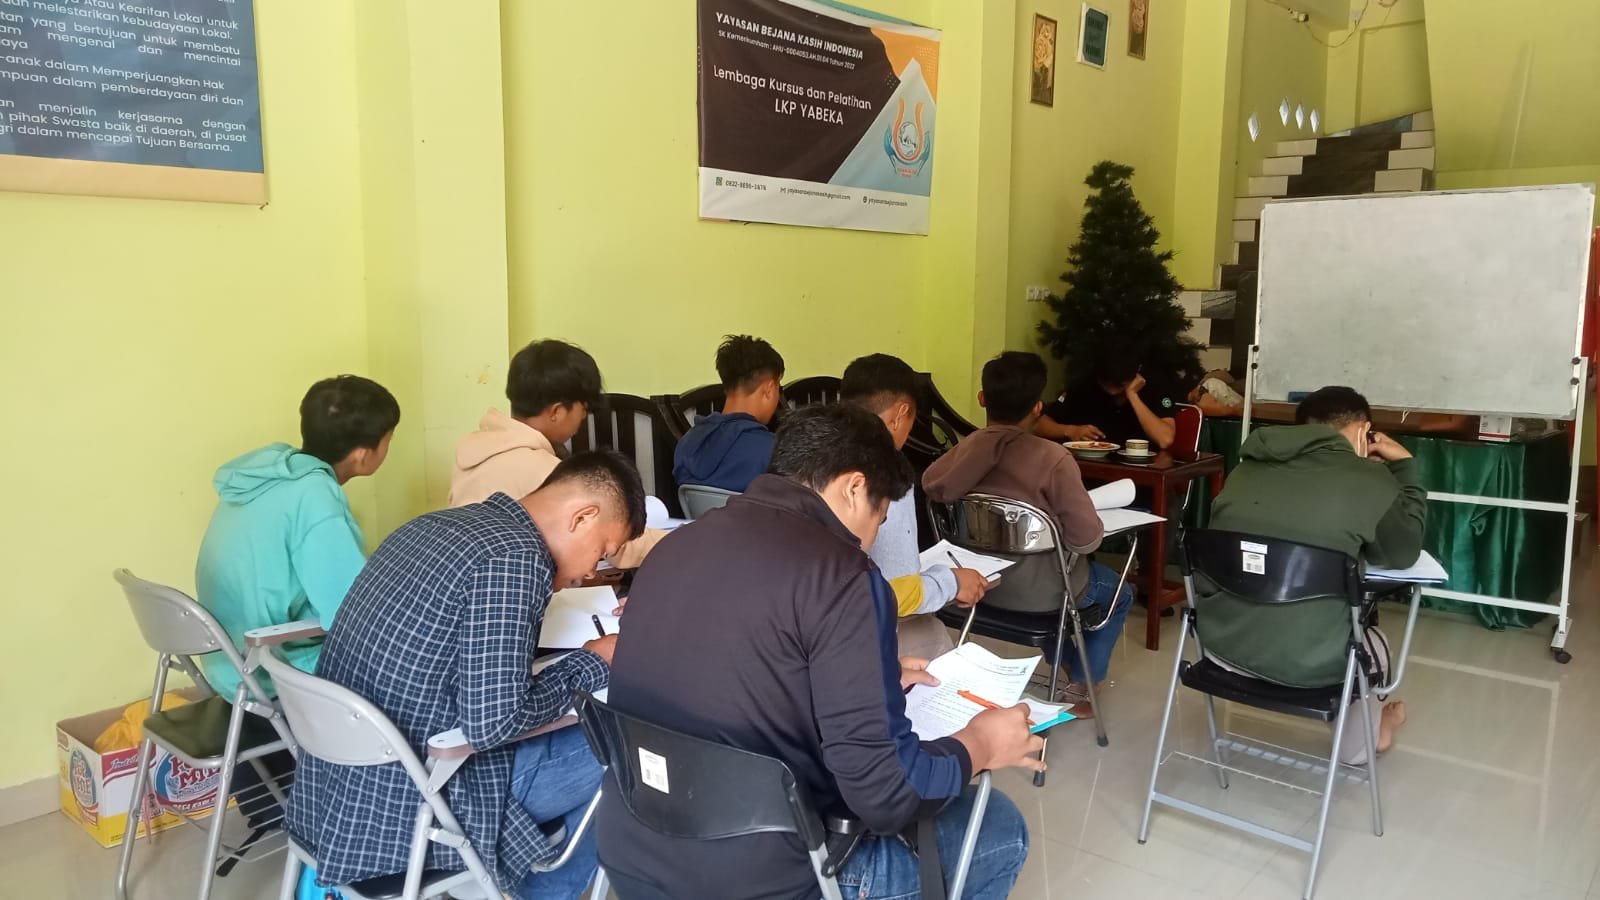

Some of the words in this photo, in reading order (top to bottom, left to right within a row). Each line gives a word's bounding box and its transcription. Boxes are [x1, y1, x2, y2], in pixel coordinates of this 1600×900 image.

[33, 1, 119, 22] melestarikan
[122, 14, 199, 34] kebudayaan
[202, 28, 232, 40] Lokal.
[85, 0, 114, 9] Atau
[174, 11, 202, 24] Lokal
[206, 18, 239, 29] untuk
[30, 16, 66, 32] yang
[74, 22, 136, 40] bertujuan
[144, 34, 177, 46] untuk
[184, 40, 240, 54] membatu
[48, 32, 115, 48] mengenal
[138, 45, 162, 55] dan
[184, 52, 240, 66] mencintai
[716, 12, 760, 33] YAYASAN
[761, 25, 796, 42] BEJANA
[797, 34, 823, 49] KASIH
[824, 40, 864, 60] INDONESIA
[44, 60, 88, 72] dalam
[92, 65, 200, 86] Memperjuangkan
[203, 80, 224, 90] Hak
[714, 65, 766, 90] Lembaga
[769, 78, 804, 96] Kursus
[806, 86, 826, 100] dan
[828, 91, 872, 110] Pelatihan
[52, 76, 96, 88] dalam
[102, 82, 196, 100] pemberdayaan
[200, 94, 218, 103] diri
[222, 96, 244, 106] dan
[38, 103, 96, 116] menjalin
[118, 110, 182, 124] kerjasama
[202, 119, 246, 132] dengan
[775, 98, 796, 115] LKP
[800, 104, 844, 125] YABEKA
[8, 112, 48, 124] pihak
[52, 116, 100, 129] Swasta
[104, 121, 132, 132] baik
[136, 124, 147, 132] di
[152, 126, 197, 138] daerah,
[201, 130, 212, 139] di
[215, 132, 246, 142] pusat
[18, 126, 62, 137] dalam
[66, 130, 132, 144] mencapai
[136, 136, 176, 148] Tujuan
[180, 140, 232, 152] Bersama.
